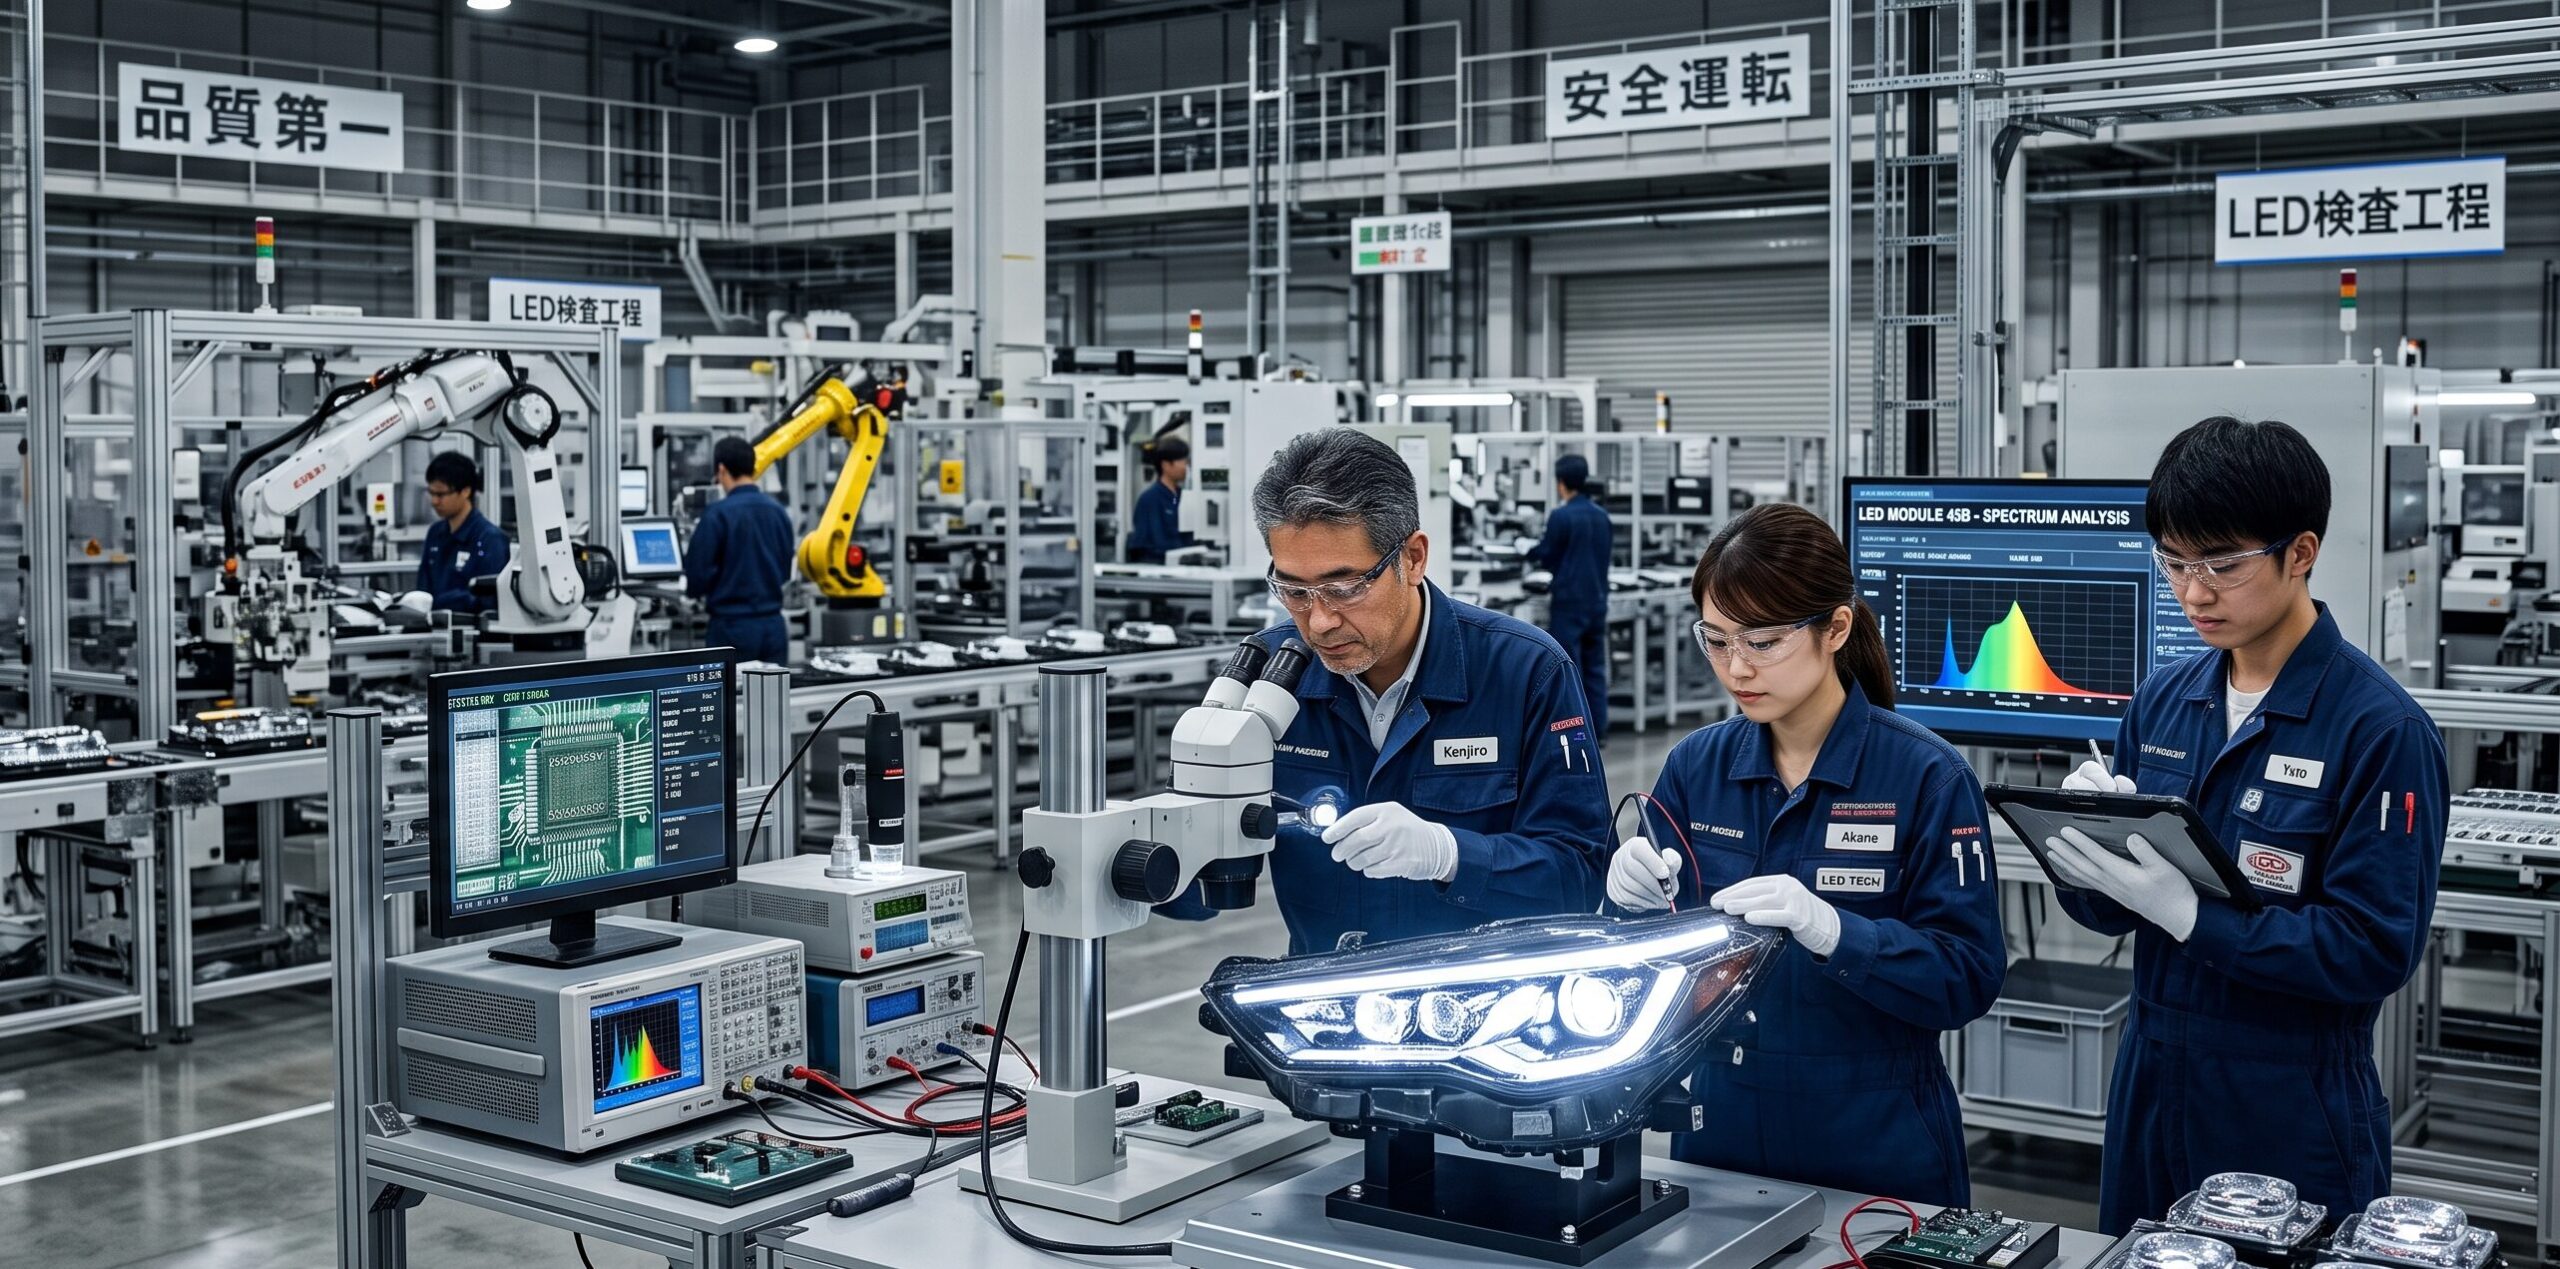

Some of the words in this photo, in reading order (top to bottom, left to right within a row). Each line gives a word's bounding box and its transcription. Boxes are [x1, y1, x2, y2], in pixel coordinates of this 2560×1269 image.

[1563, 51, 1792, 123] 安全運転
[135, 78, 391, 153] 品質第一
[2228, 183, 2491, 239] LED検査工程
[509, 294, 643, 328] LED検査工程
[1858, 507, 1885, 521] LED
[1887, 507, 1944, 522] MODULE
[1946, 508, 1971, 523] 45B
[1982, 508, 2058, 524] SPECTRUM
[2060, 509, 2130, 526] ANALYSIS
[1443, 745, 1488, 760] Kenjiro
[1841, 831, 1879, 844] Akane
[1821, 875, 1846, 886] LED
